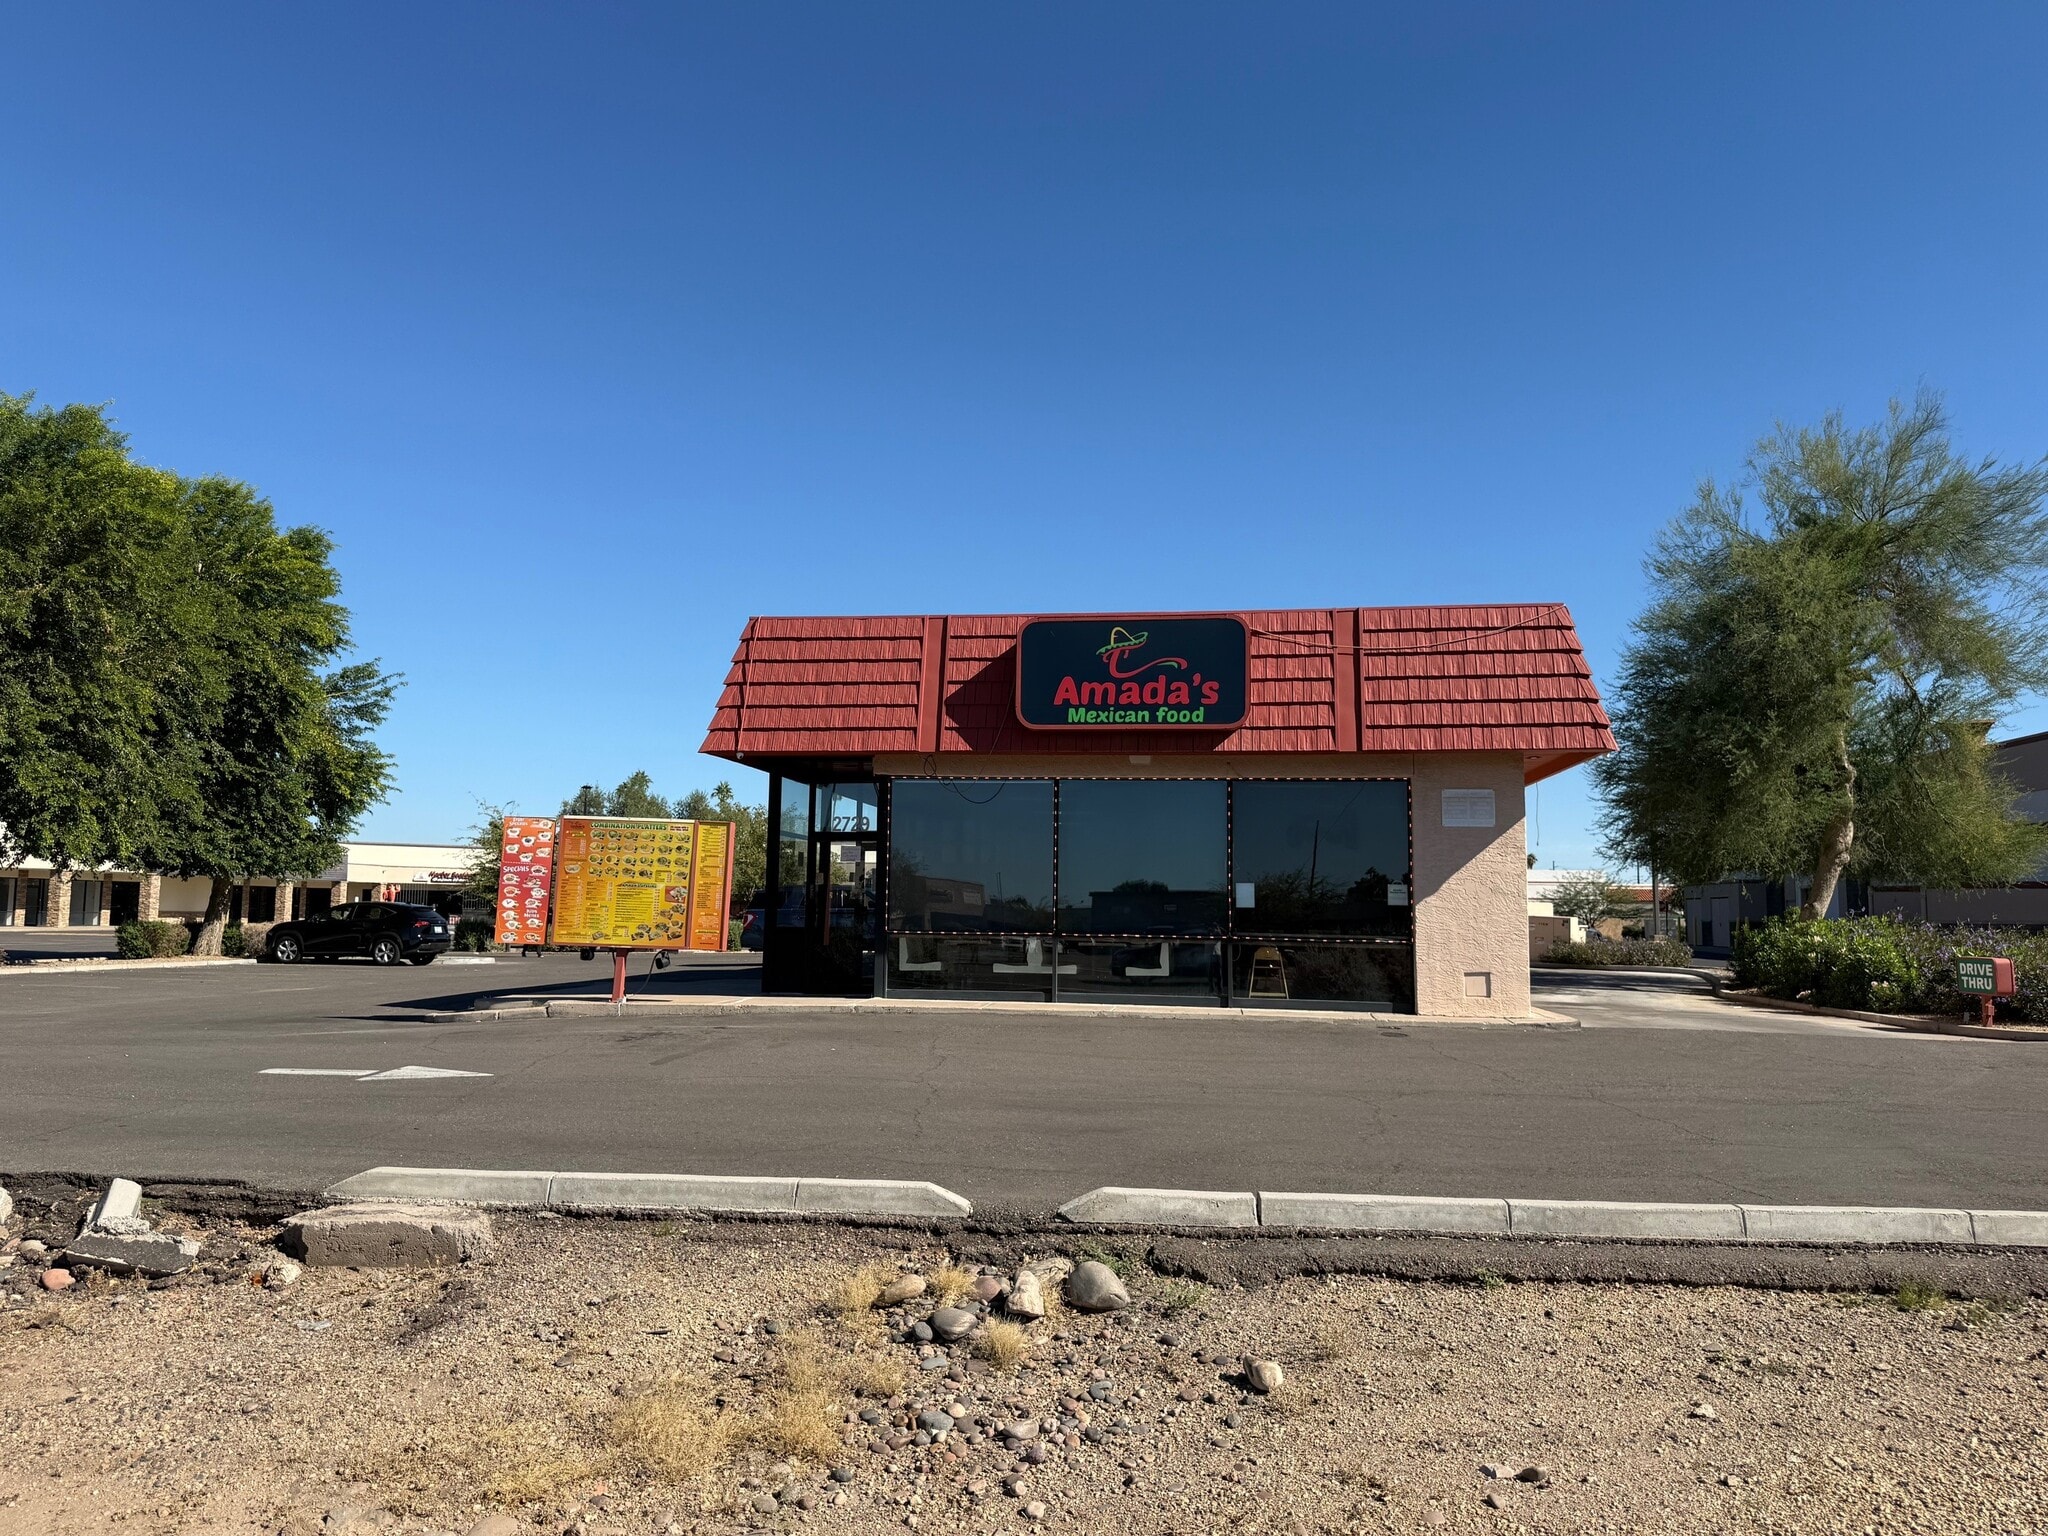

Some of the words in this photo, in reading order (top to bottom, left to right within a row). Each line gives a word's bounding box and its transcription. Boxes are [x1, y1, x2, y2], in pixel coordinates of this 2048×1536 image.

[1053, 673, 1219, 705] Amada's
[1067, 707, 1149, 723] Mexican
[1156, 706, 1204, 723] food
[591, 822, 636, 830] COMBINATION
[833, 816, 870, 831] 2729
[1959, 962, 1993, 976] DRIVE
[1961, 976, 1992, 990] THRU
